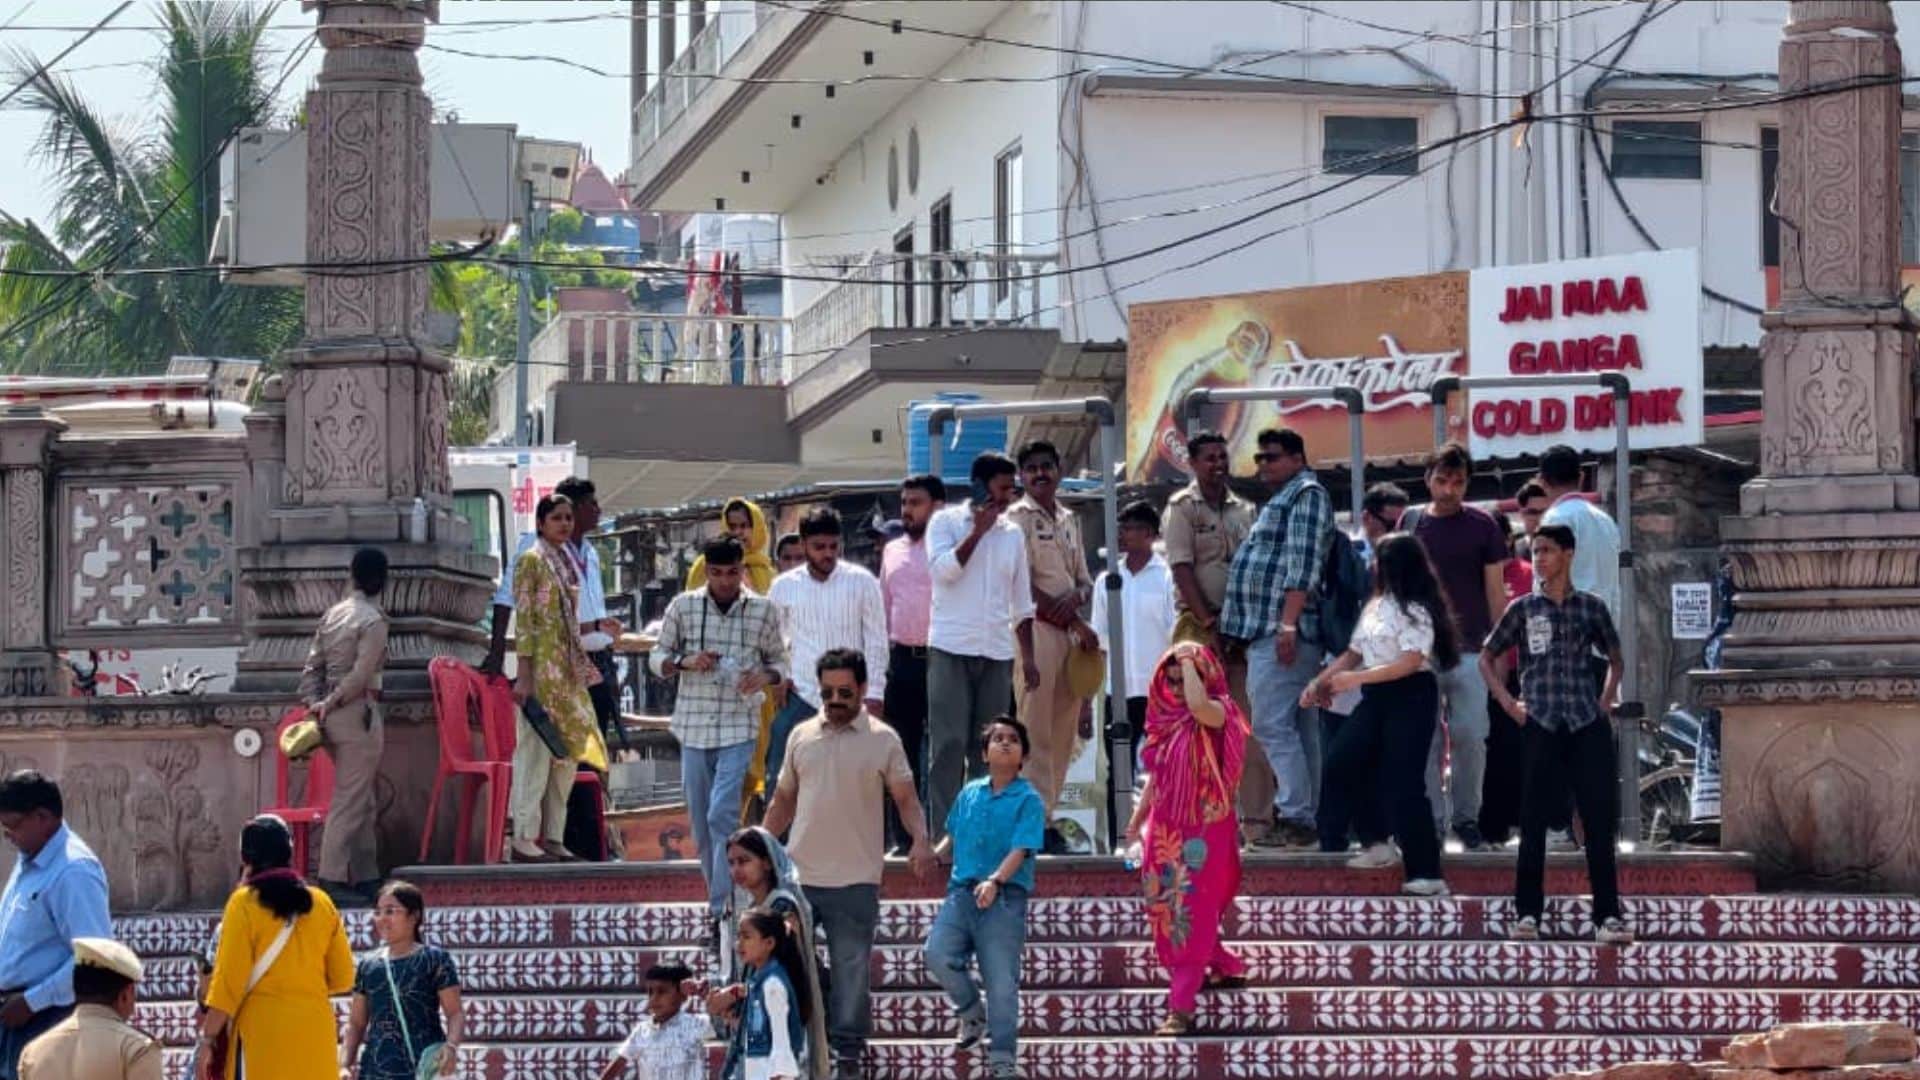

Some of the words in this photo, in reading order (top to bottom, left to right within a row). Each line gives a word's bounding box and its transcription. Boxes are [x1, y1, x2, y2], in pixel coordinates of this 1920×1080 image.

[1499, 284, 1553, 324] JAI
[1562, 276, 1648, 317] MAA
[1508, 334, 1643, 375] GANGA
[1472, 397, 1568, 439] COLD
[1573, 387, 1684, 432] DRNK
